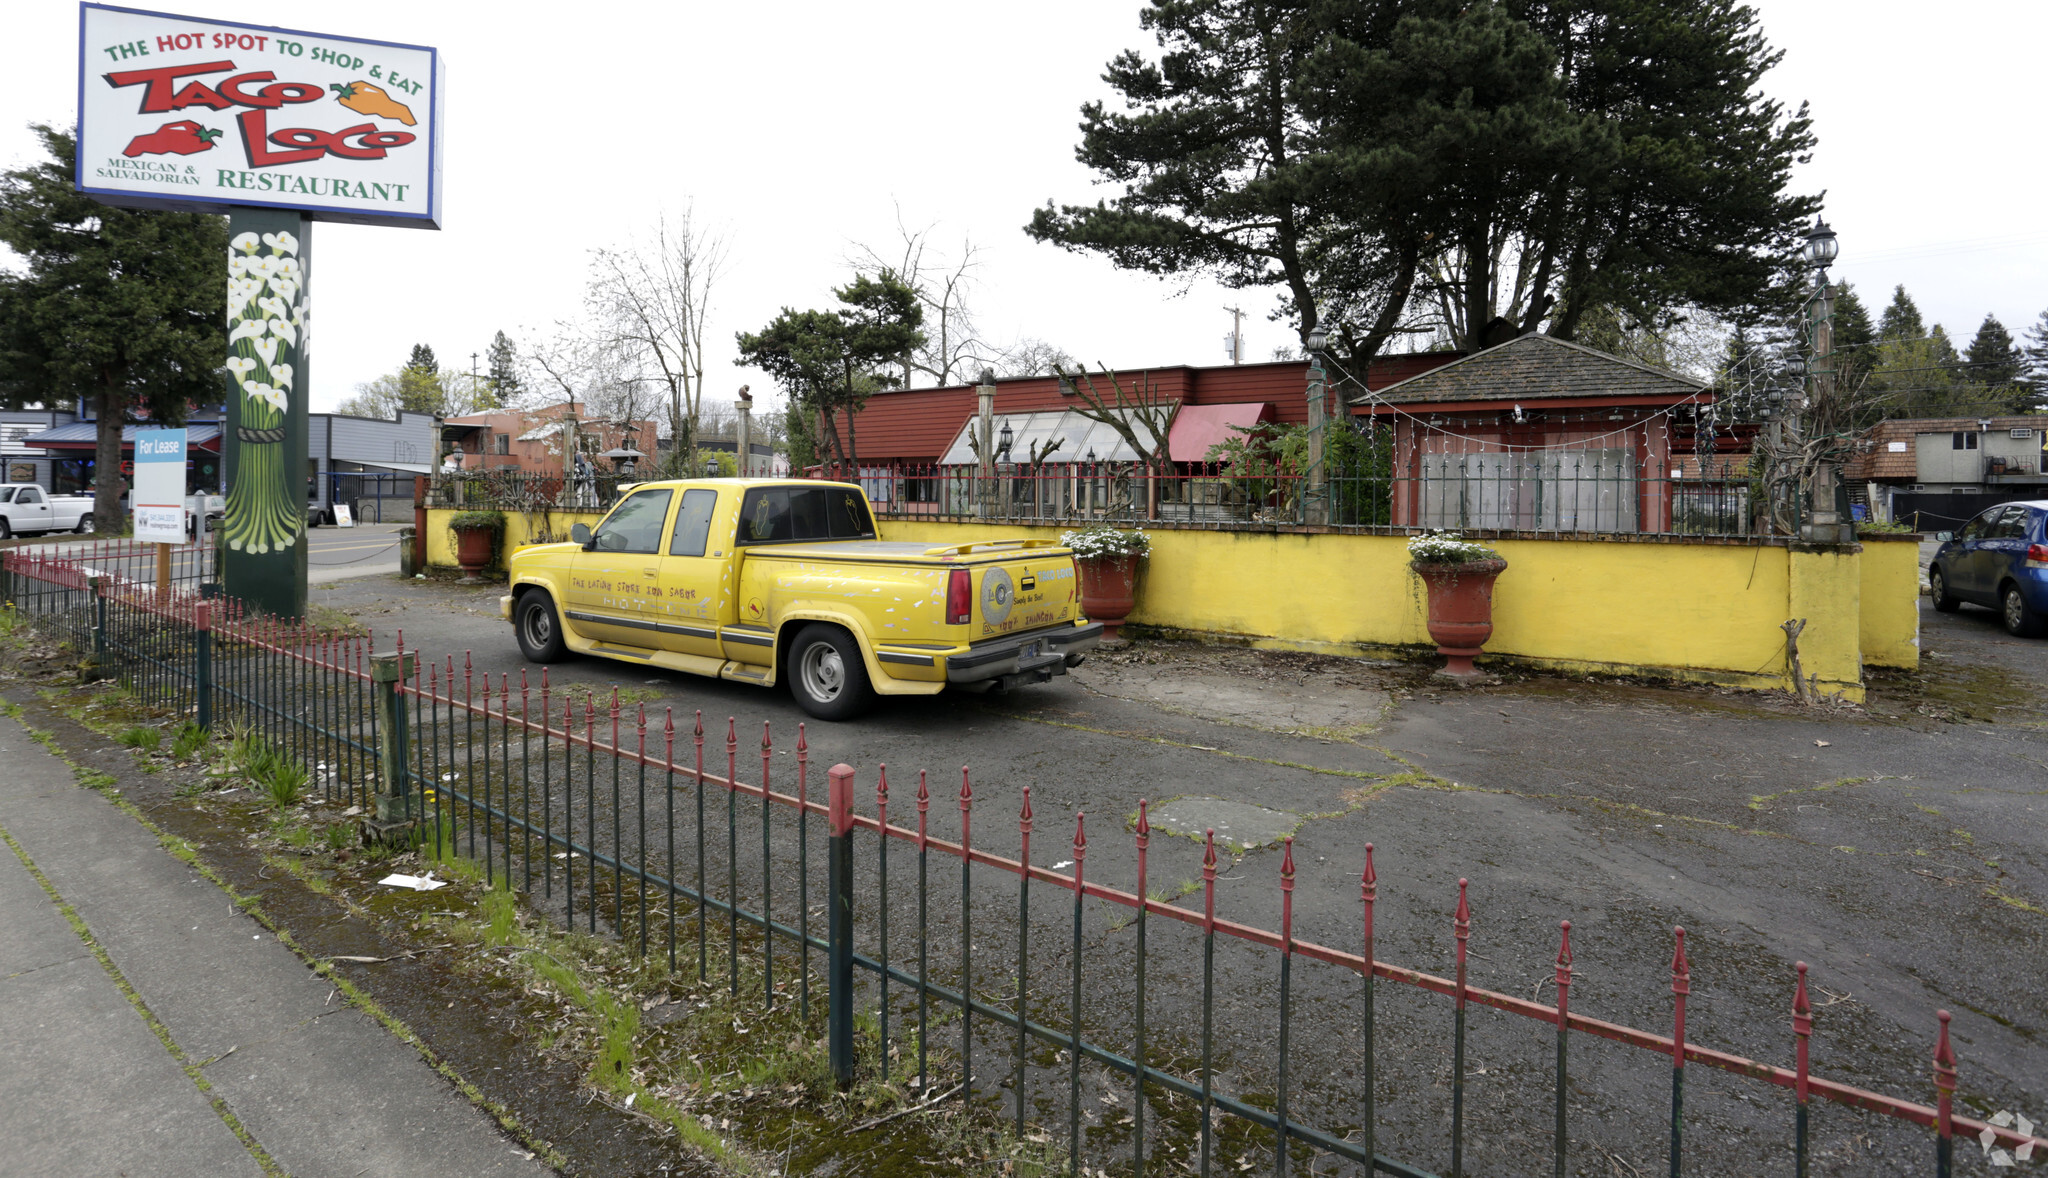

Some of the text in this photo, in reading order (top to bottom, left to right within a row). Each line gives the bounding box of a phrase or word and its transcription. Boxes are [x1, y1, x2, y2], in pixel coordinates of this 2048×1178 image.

[104, 33, 423, 96] THE HOT SPOT TO SHOP & EAT
[102, 60, 325, 114] TACO
[236, 109, 416, 169] LOCO
[96, 167, 200, 186] SALVADORIAN
[107, 158, 196, 175] MEXICAN &
[216, 168, 409, 203] RESTAURANT
[140, 439, 180, 454] For Lease
[1037, 567, 1074, 582] TACO LOCO
